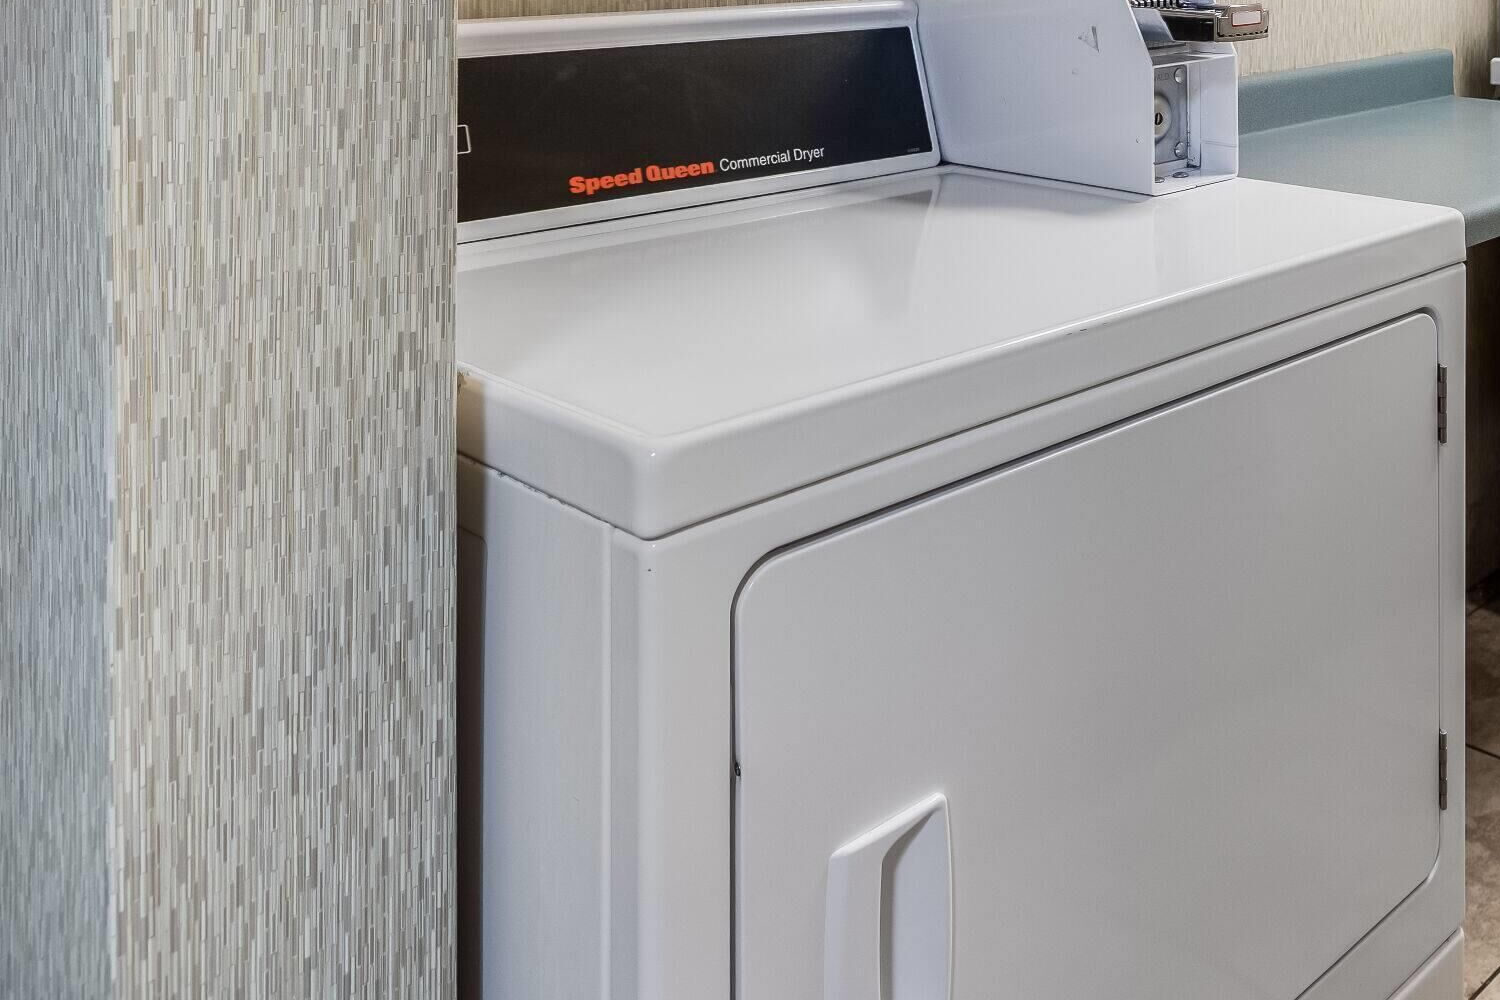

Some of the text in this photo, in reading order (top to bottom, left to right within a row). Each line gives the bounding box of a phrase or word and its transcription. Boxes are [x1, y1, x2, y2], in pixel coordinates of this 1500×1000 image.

[568, 146, 825, 196] Speed Queen Commercial Dryer
